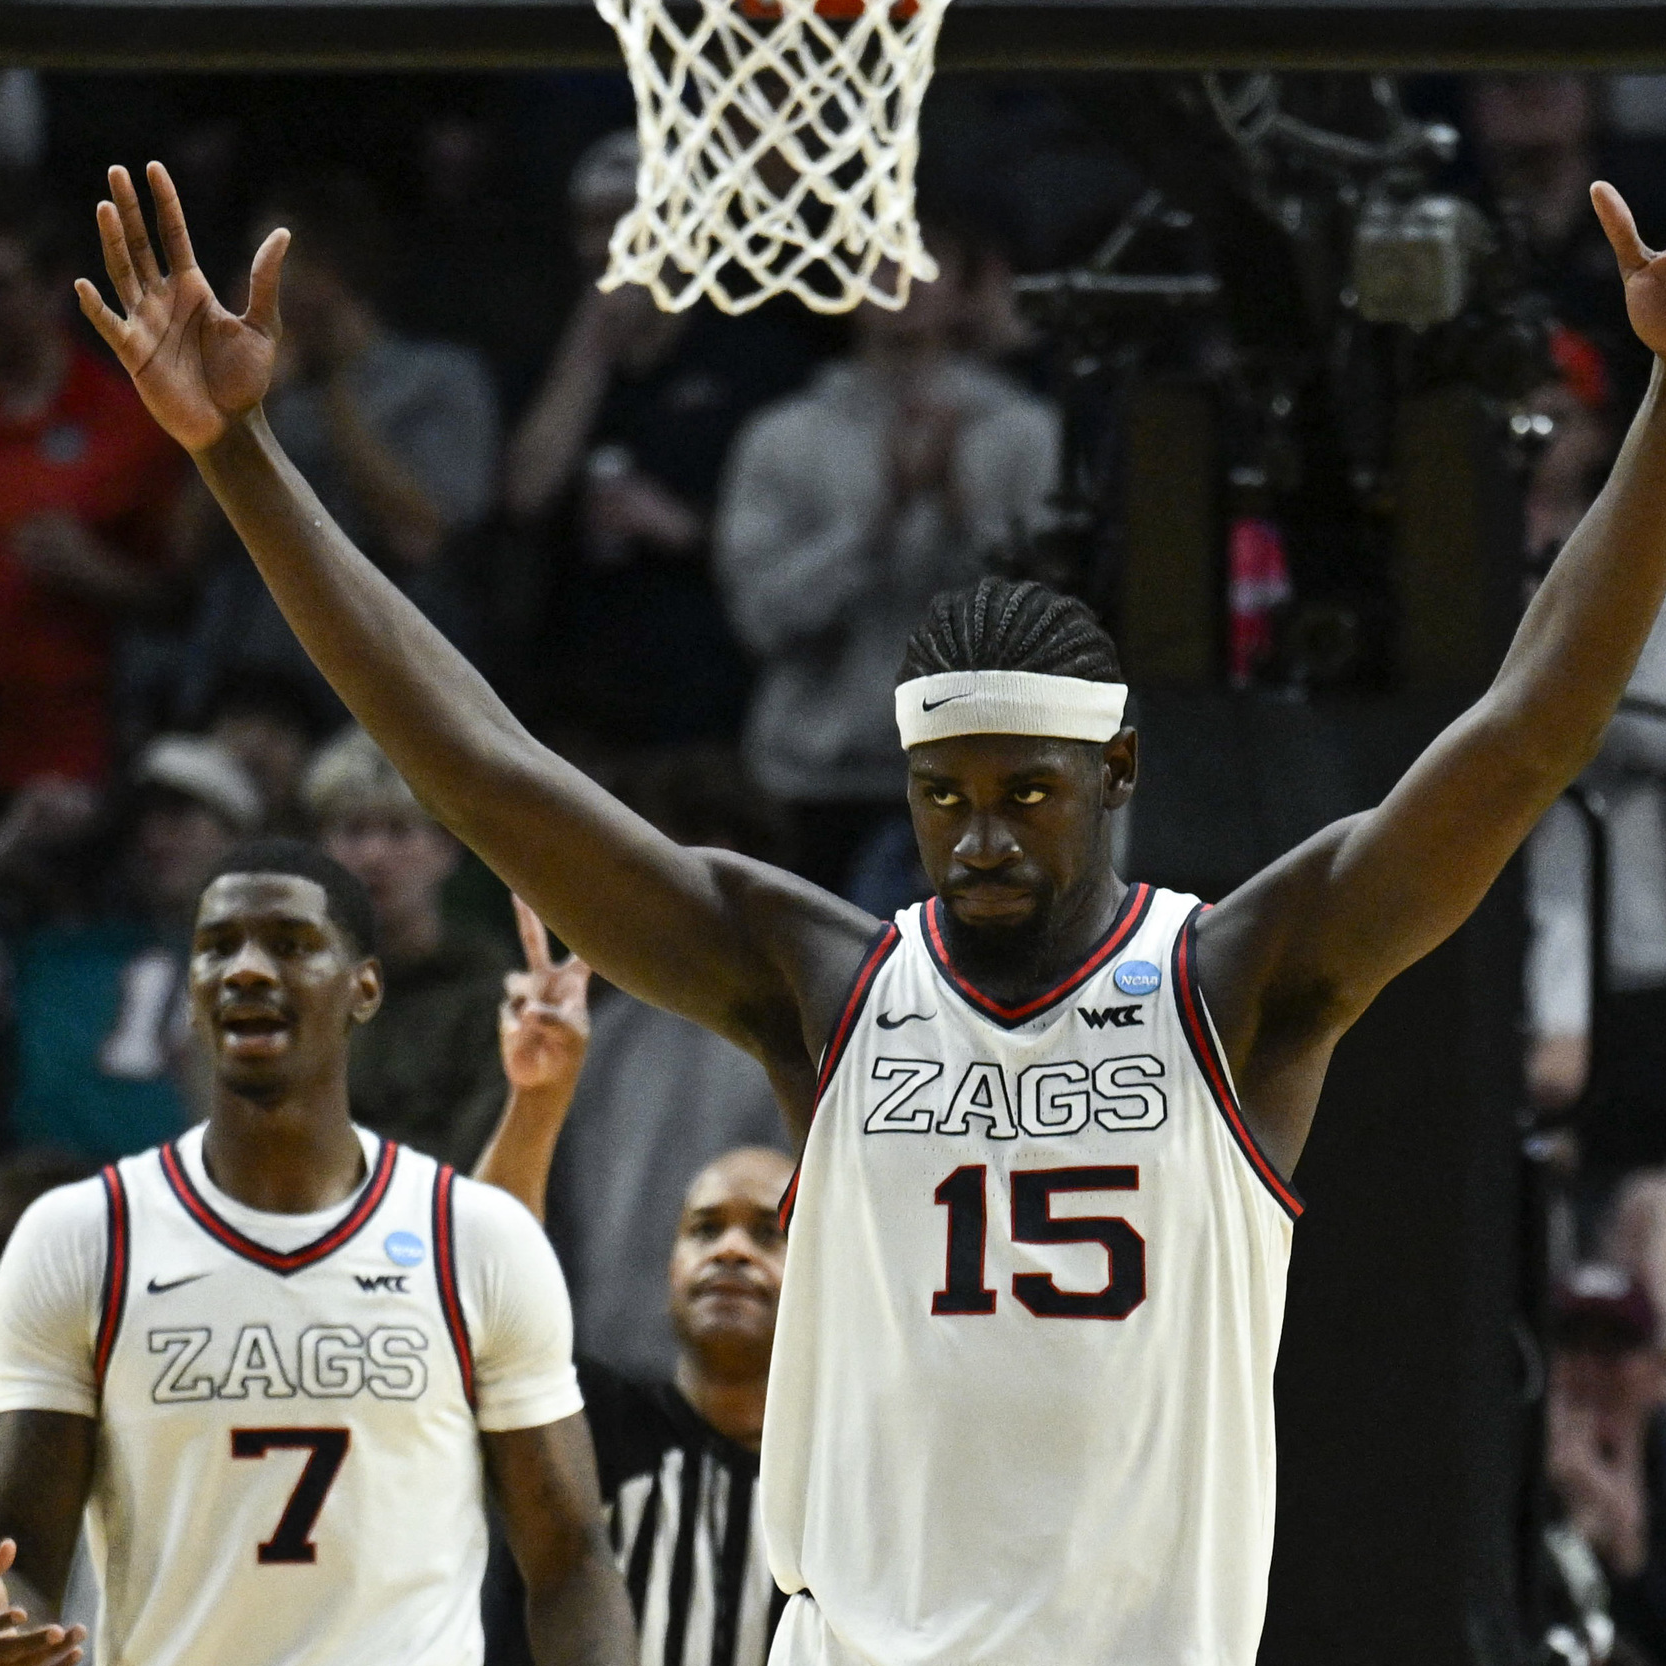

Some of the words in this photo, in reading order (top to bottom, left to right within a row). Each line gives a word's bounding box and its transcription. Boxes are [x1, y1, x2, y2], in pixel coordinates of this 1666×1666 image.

[1077, 1003, 1145, 1030] WCC
[864, 1053, 1168, 1140] ZAGS
[930, 1163, 1147, 1321] 15
[148, 1325, 429, 1403] ZAGS
[231, 1427, 351, 1565] 7
